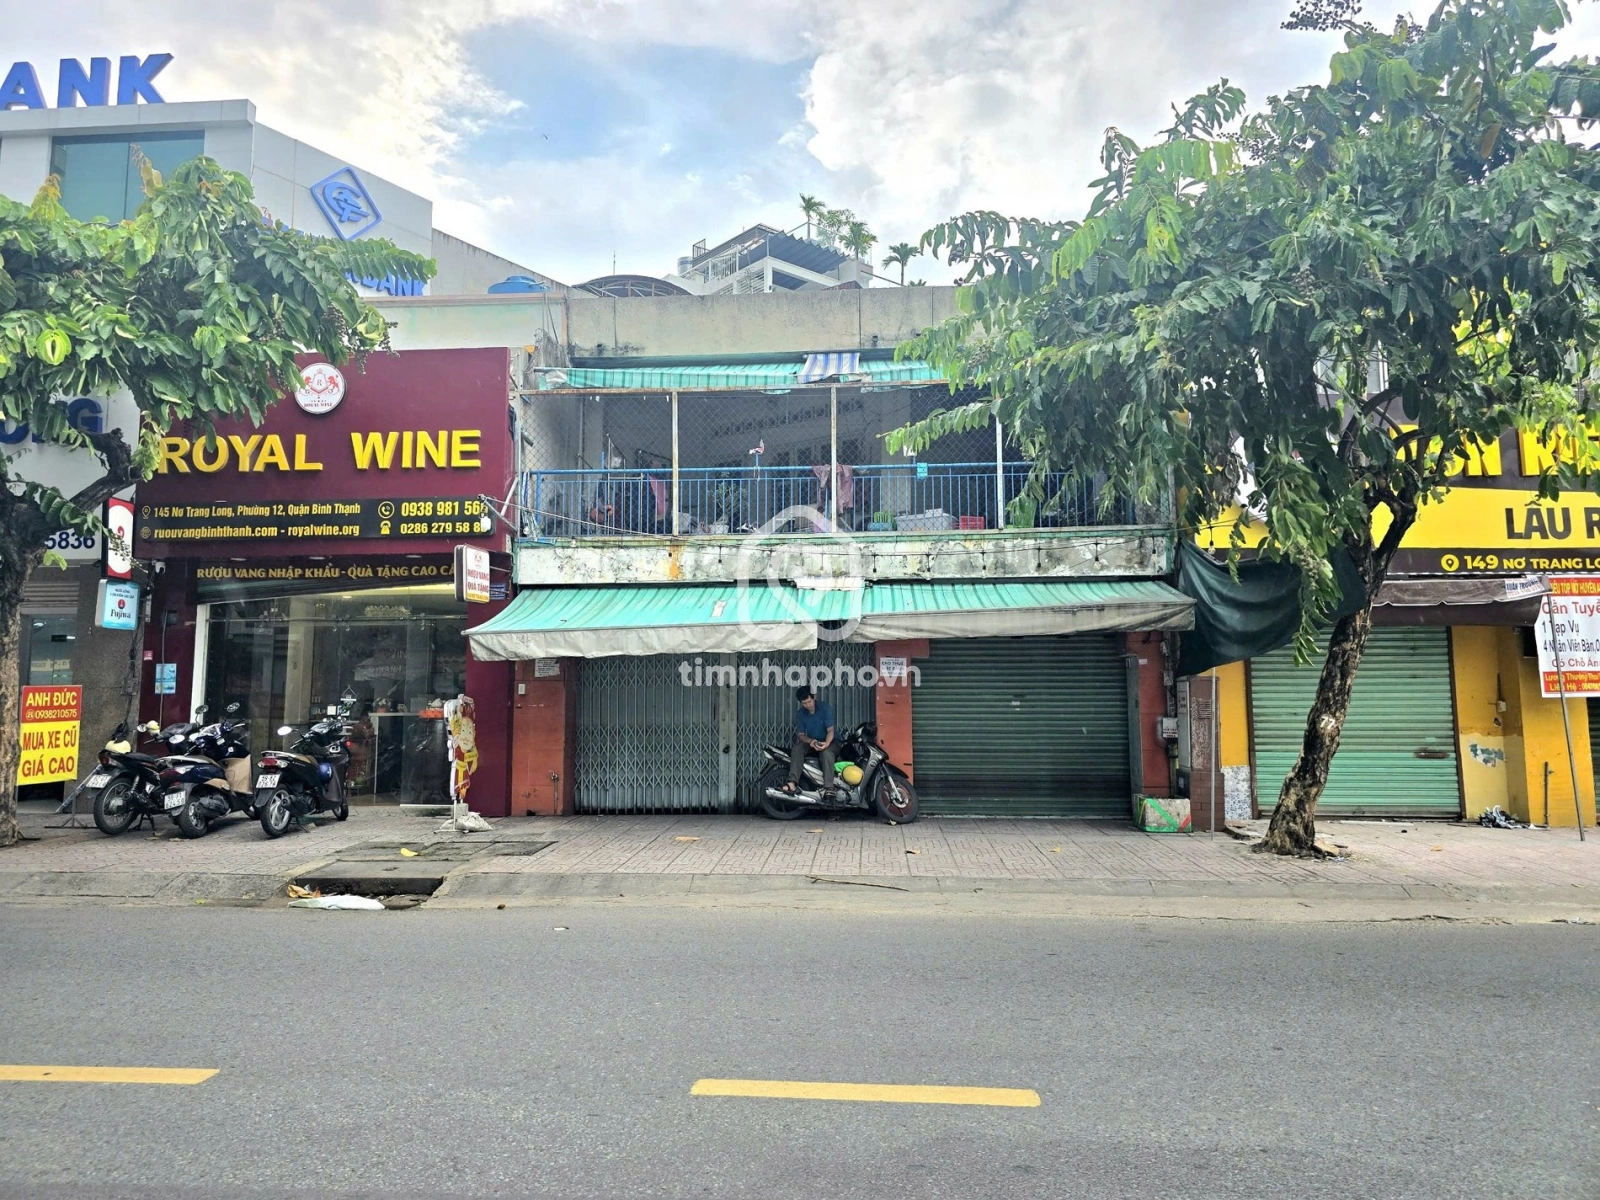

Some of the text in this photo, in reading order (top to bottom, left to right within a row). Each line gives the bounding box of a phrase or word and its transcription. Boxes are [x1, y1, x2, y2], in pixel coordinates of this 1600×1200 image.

[157, 429, 482, 474] ROYAL WINE
[154, 502, 360, 518] 145 Nơ Trang Long, Phường 12, Quận Bình Thạnh
[401, 502, 433, 517] 0938
[437, 501, 459, 516] 981
[154, 525, 277, 539] ruouvangbinhthanh.com
[288, 523, 360, 537] royalwine.org
[401, 523, 428, 534] 0286
[431, 522, 452, 534] 279
[456, 522, 469, 533] 58
[1464, 554, 1498, 569] 149
[1503, 557, 1526, 569] NƠ
[1530, 558, 1583, 570] TRANG
[197, 565, 233, 580] RƯỢU
[234, 568, 266, 579] VANG
[268, 565, 301, 580] NHẬP
[305, 562, 340, 578] KHẨU
[348, 562, 373, 578] QUÀ
[377, 564, 409, 579] TẶNG
[411, 565, 438, 577] CAO
[111, 609, 131, 619] Fujiwa
[1568, 620, 1579, 636] Vụ
[1543, 640, 1547, 652] 4
[1549, 639, 1566, 652] Nân
[1567, 639, 1581, 652] Viên
[1545, 673, 1565, 682] Lươg
[26, 688, 77, 706] ANH ĐỨC
[36, 709, 77, 719] 0938210575
[23, 725, 77, 751] MUA XE CŨ
[22, 754, 75, 777] GIÁ CAO
